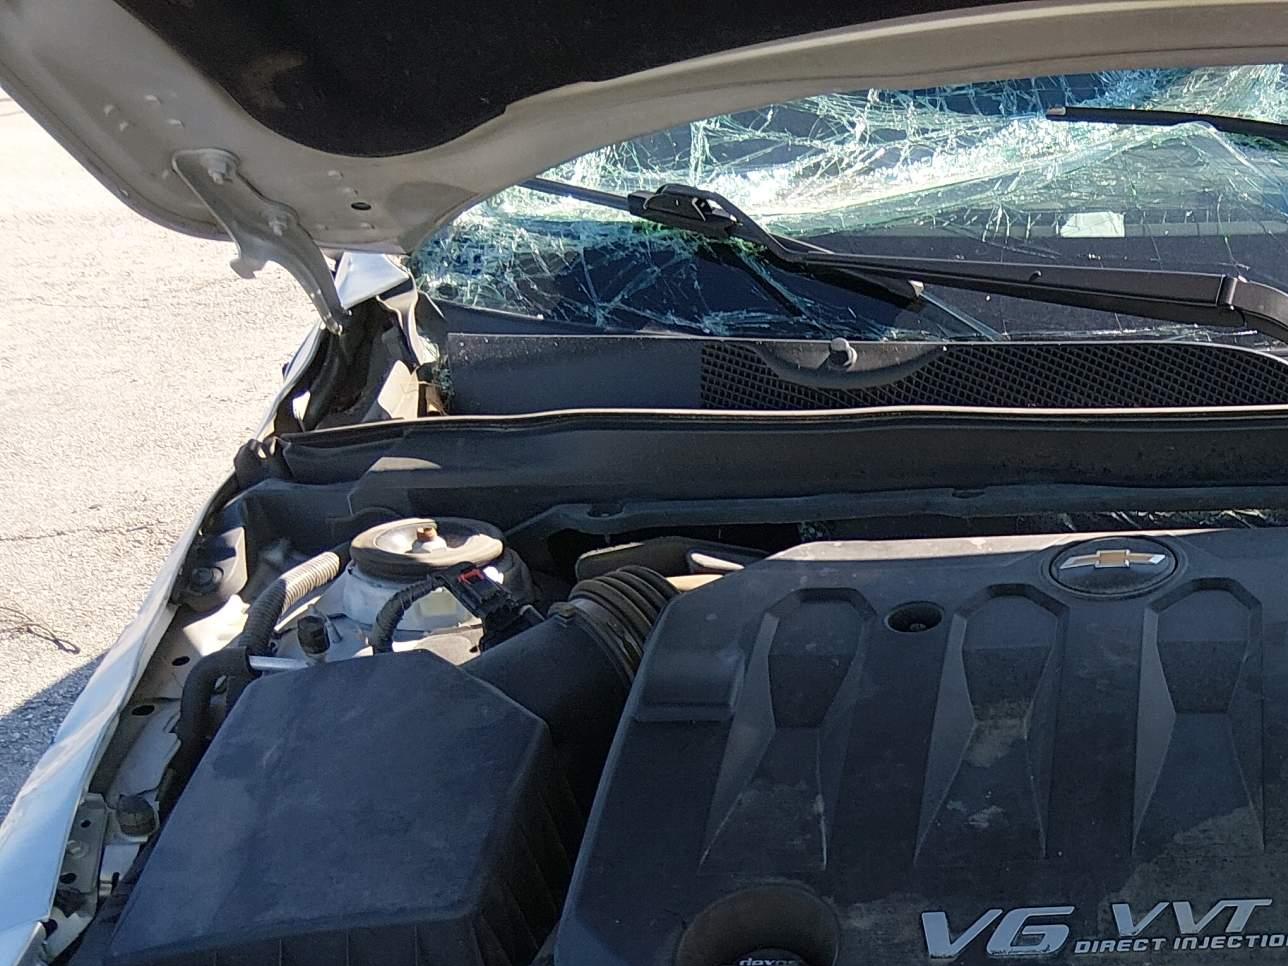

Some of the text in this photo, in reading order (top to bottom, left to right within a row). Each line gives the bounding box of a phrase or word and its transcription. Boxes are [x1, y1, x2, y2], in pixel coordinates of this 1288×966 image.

[921, 899, 1273, 958] V6 VVT
[1074, 937, 1167, 953] DIRECT
